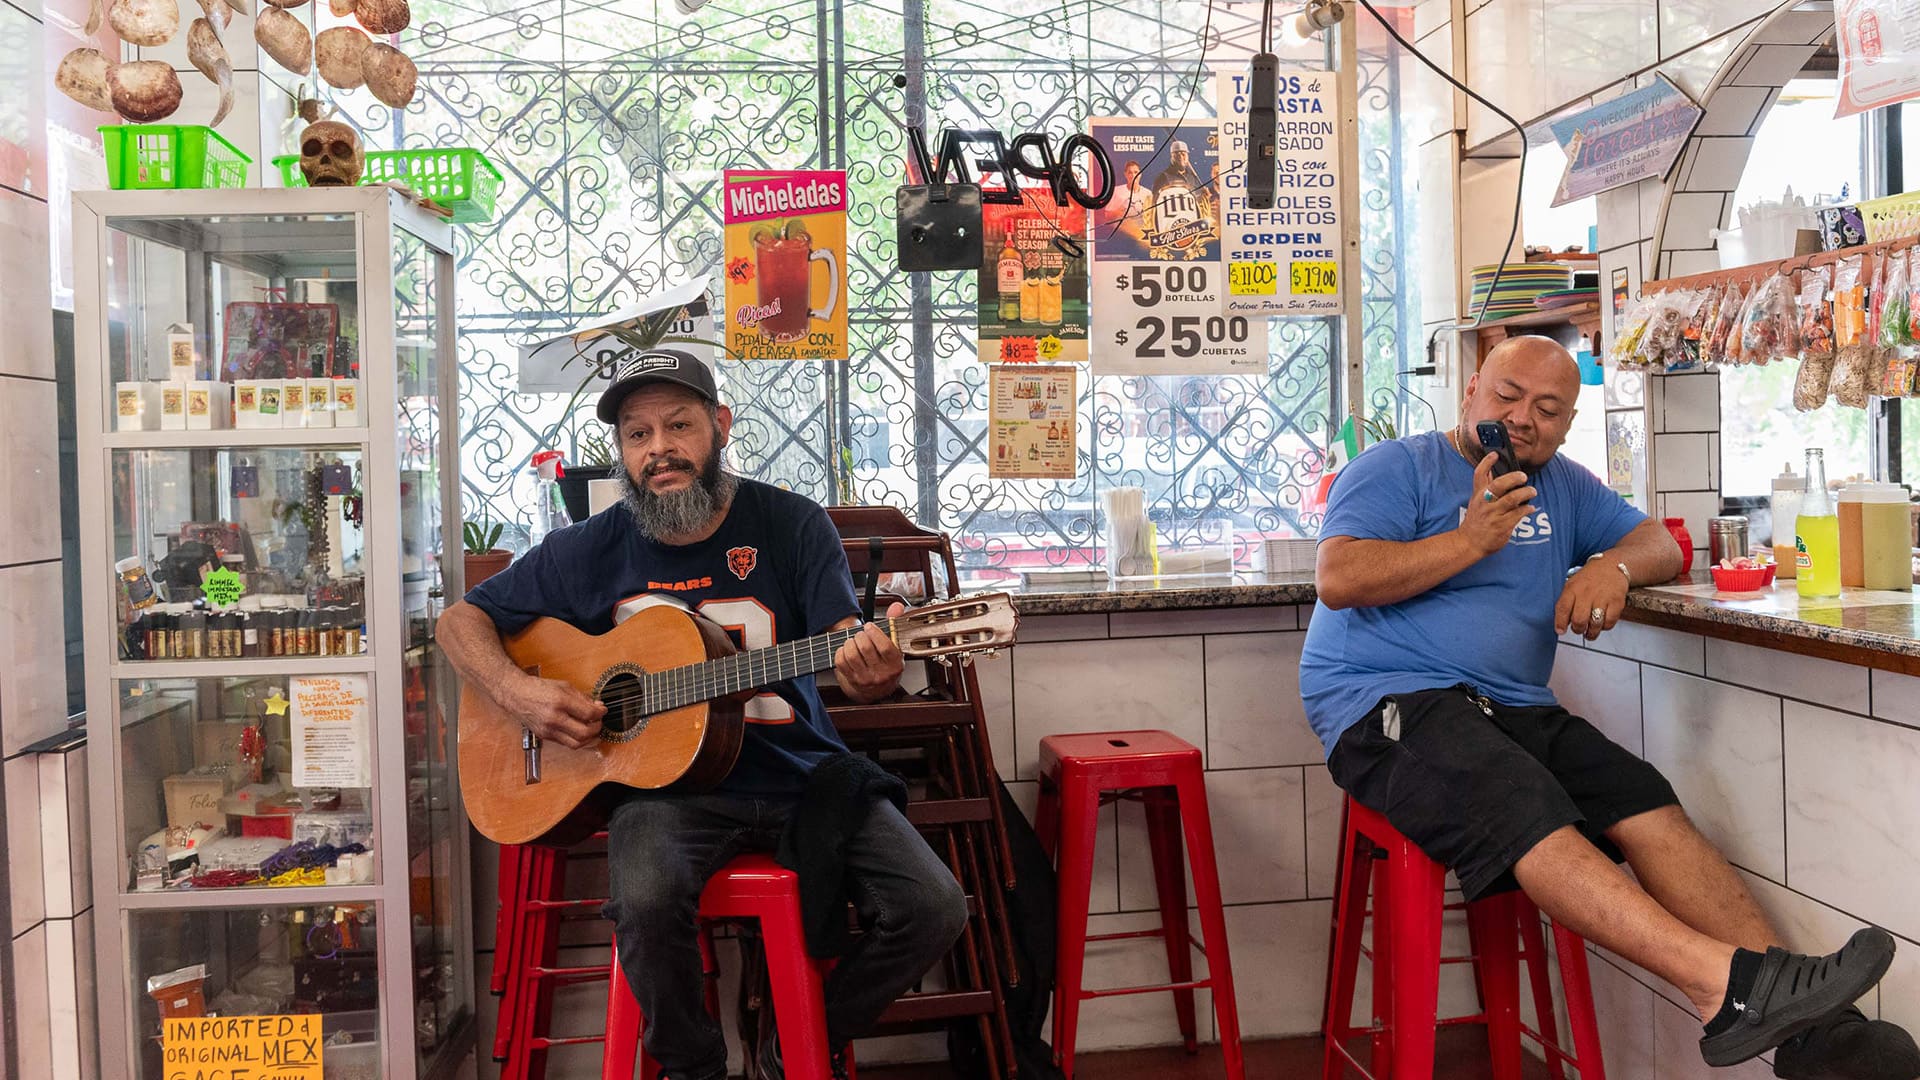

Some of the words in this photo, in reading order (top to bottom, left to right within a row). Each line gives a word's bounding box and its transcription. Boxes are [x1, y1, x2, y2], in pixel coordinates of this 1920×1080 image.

[1232, 76, 1300, 94] TOS
[1308, 78, 1321, 92] de
[1233, 96, 1323, 113] CASTA
[1223, 122, 1333, 135] CHARRON
[1113, 144, 1129, 152] LESS
[1130, 144, 1155, 152] FILLING
[1233, 137, 1324, 150] PSADO
[1231, 160, 1297, 173] PAS
[1302, 161, 1328, 170] con
[1226, 174, 1335, 188] CRIZO
[730, 179, 841, 217] Micheladas
[1229, 196, 1332, 209] FOLES
[1226, 212, 1336, 225] REFRITOS
[1017, 240, 1048, 249] SEASON
[1242, 233, 1322, 245] ORDEN
[1231, 251, 1273, 259] SEIS
[1292, 250, 1334, 258] DOCE
[1229, 301, 1258, 310] Ordene
[1262, 300, 1283, 309] Para
[1288, 300, 1305, 308] Sus
[1308, 299, 1338, 309] Fiestas
[170, 1017, 294, 1041] IMPORTED
[167, 1044, 260, 1063] ORIGINAL
[263, 1038, 317, 1065] MEX
